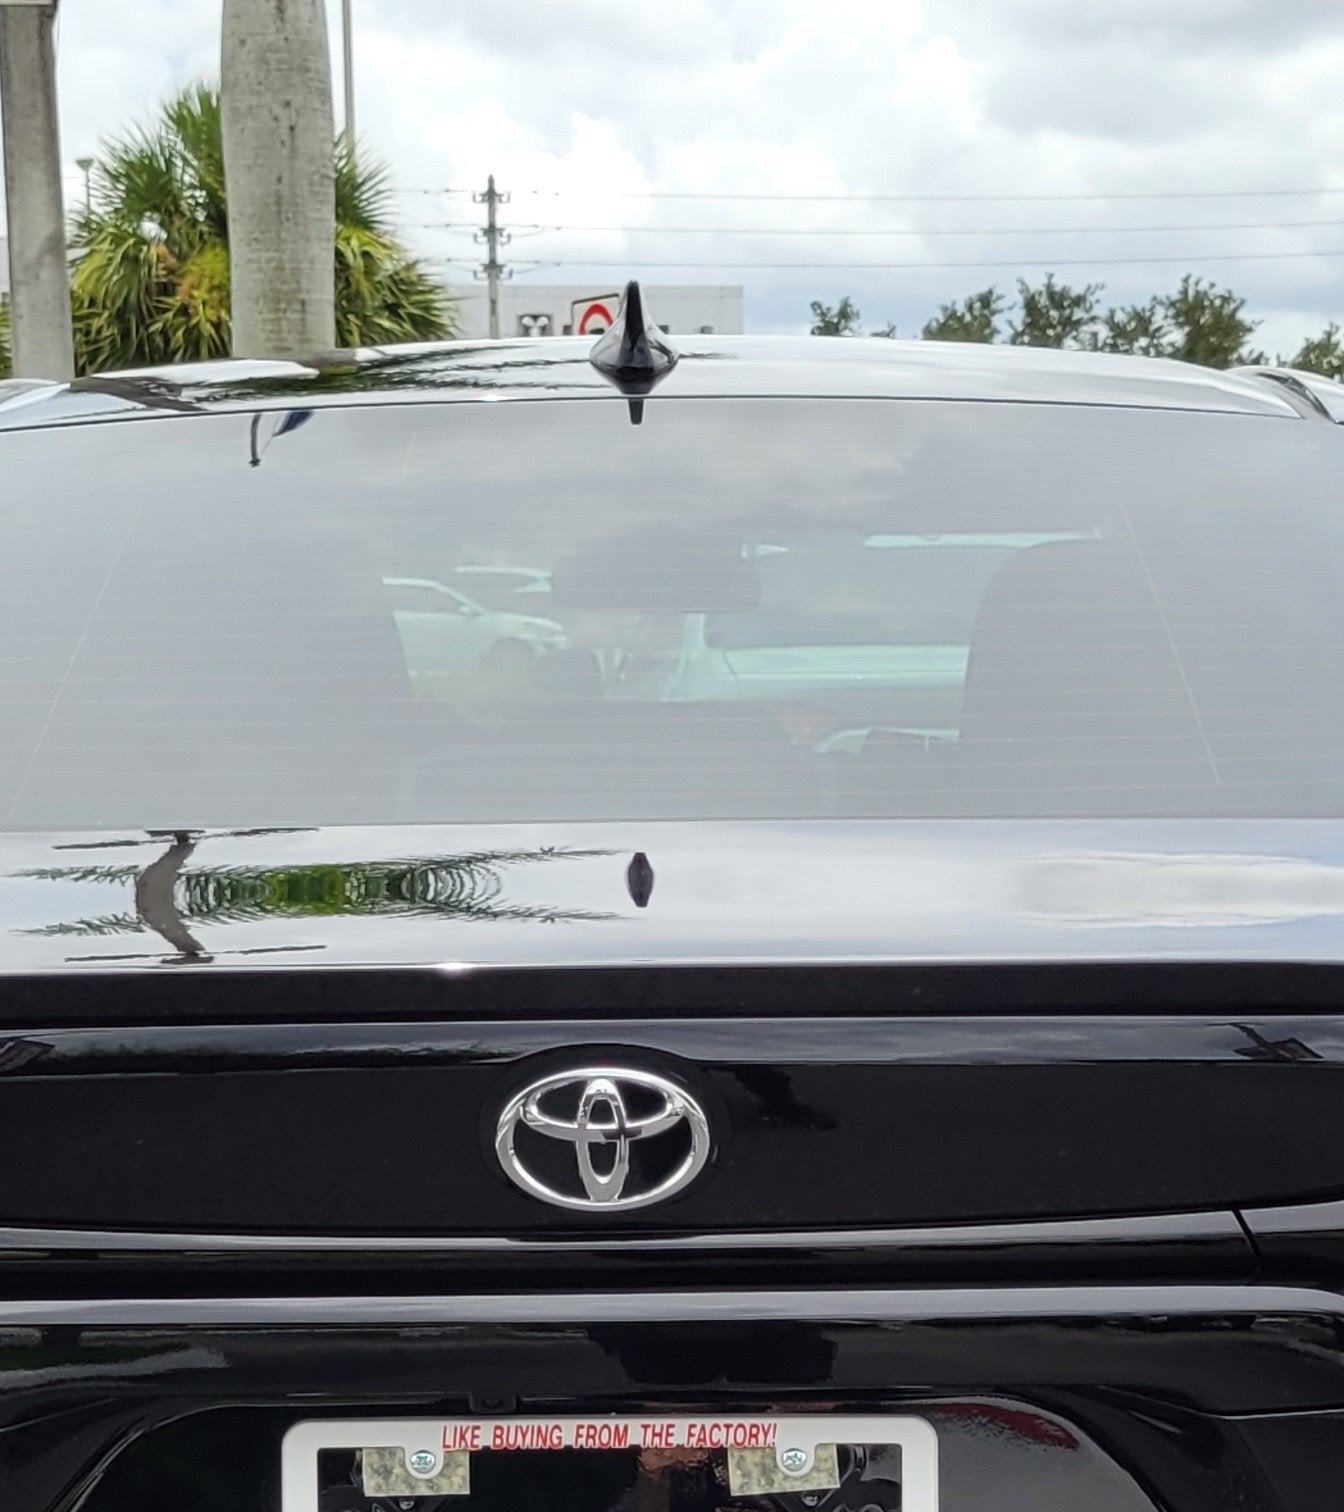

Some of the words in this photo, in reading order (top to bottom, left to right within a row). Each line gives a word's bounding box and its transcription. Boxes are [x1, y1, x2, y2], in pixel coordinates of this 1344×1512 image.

[441, 1424, 482, 1450] LIKE
[492, 1424, 563, 1450] BUYING
[573, 1423, 629, 1449] FROM
[641, 1423, 677, 1448] THE
[687, 1422, 779, 1448] FACTORY!
